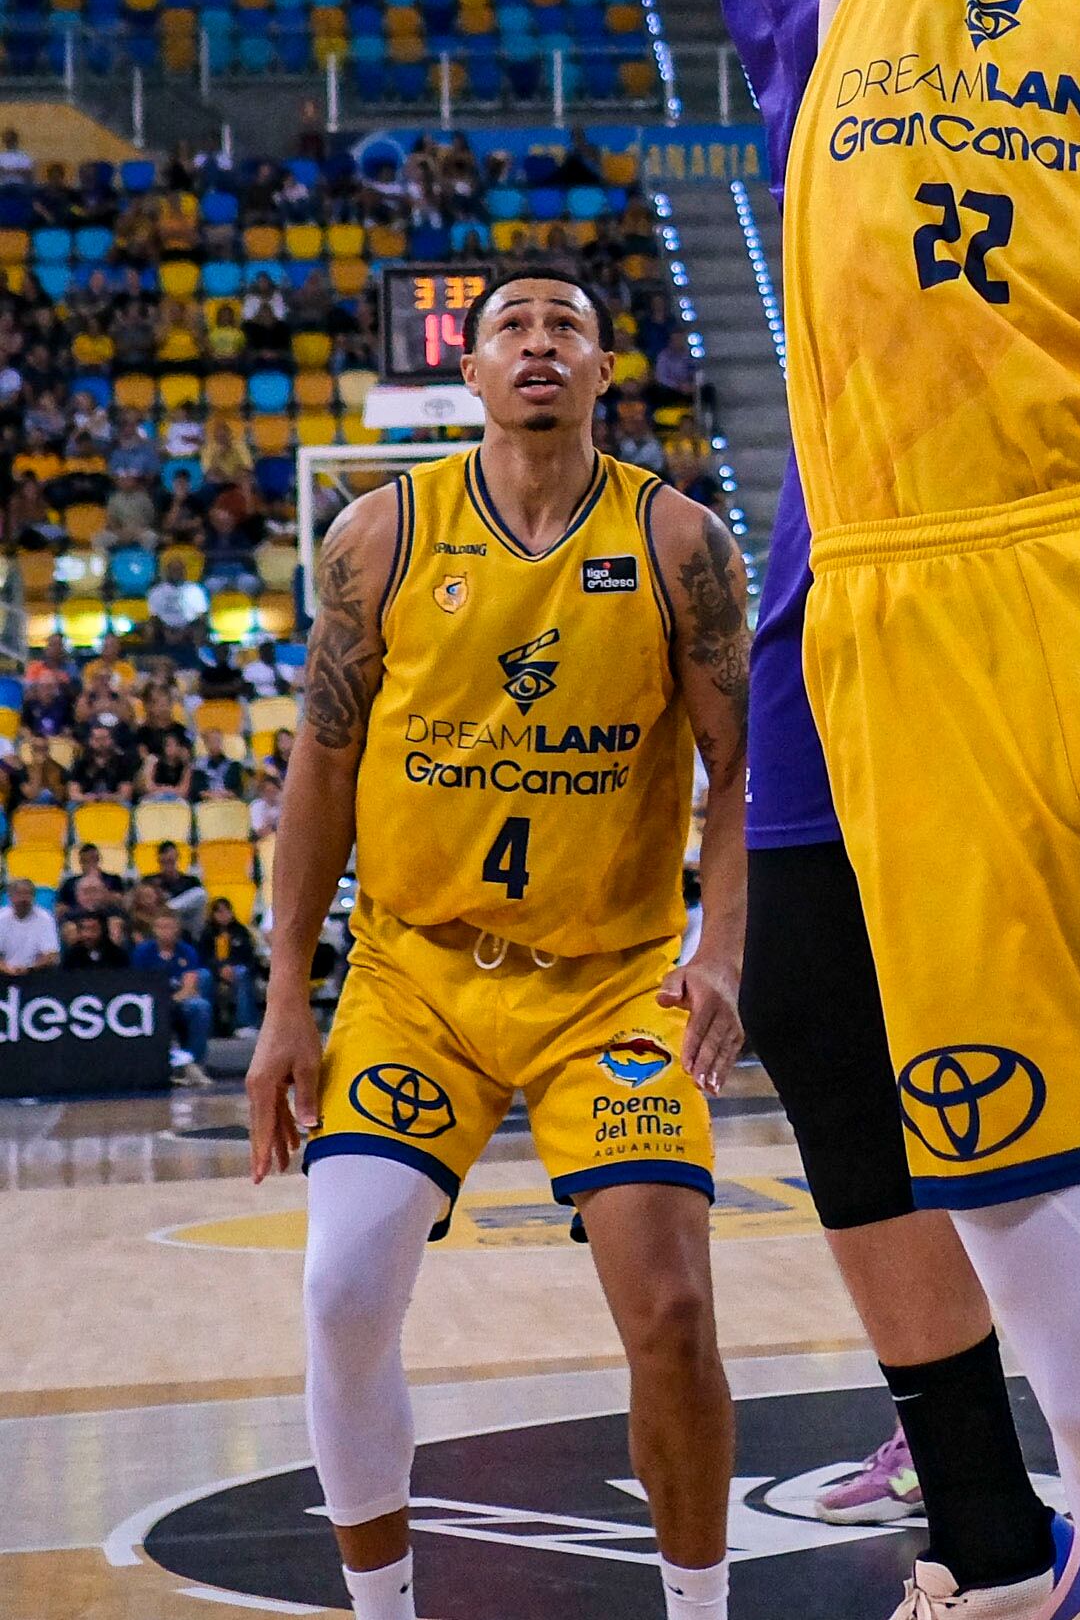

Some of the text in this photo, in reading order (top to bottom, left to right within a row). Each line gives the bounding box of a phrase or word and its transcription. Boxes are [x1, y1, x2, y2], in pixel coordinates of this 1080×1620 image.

[913, 183, 1014, 305] 22
[435, 542, 487, 556] SPALDING
[586, 567, 609, 579] liga
[587, 578, 634, 588] endesa
[482, 816, 531, 900] 4
[593, 1095, 681, 1119] Poema
[595, 1114, 683, 1142] del Mar
[594, 1143, 685, 1157] AQUARIUM
